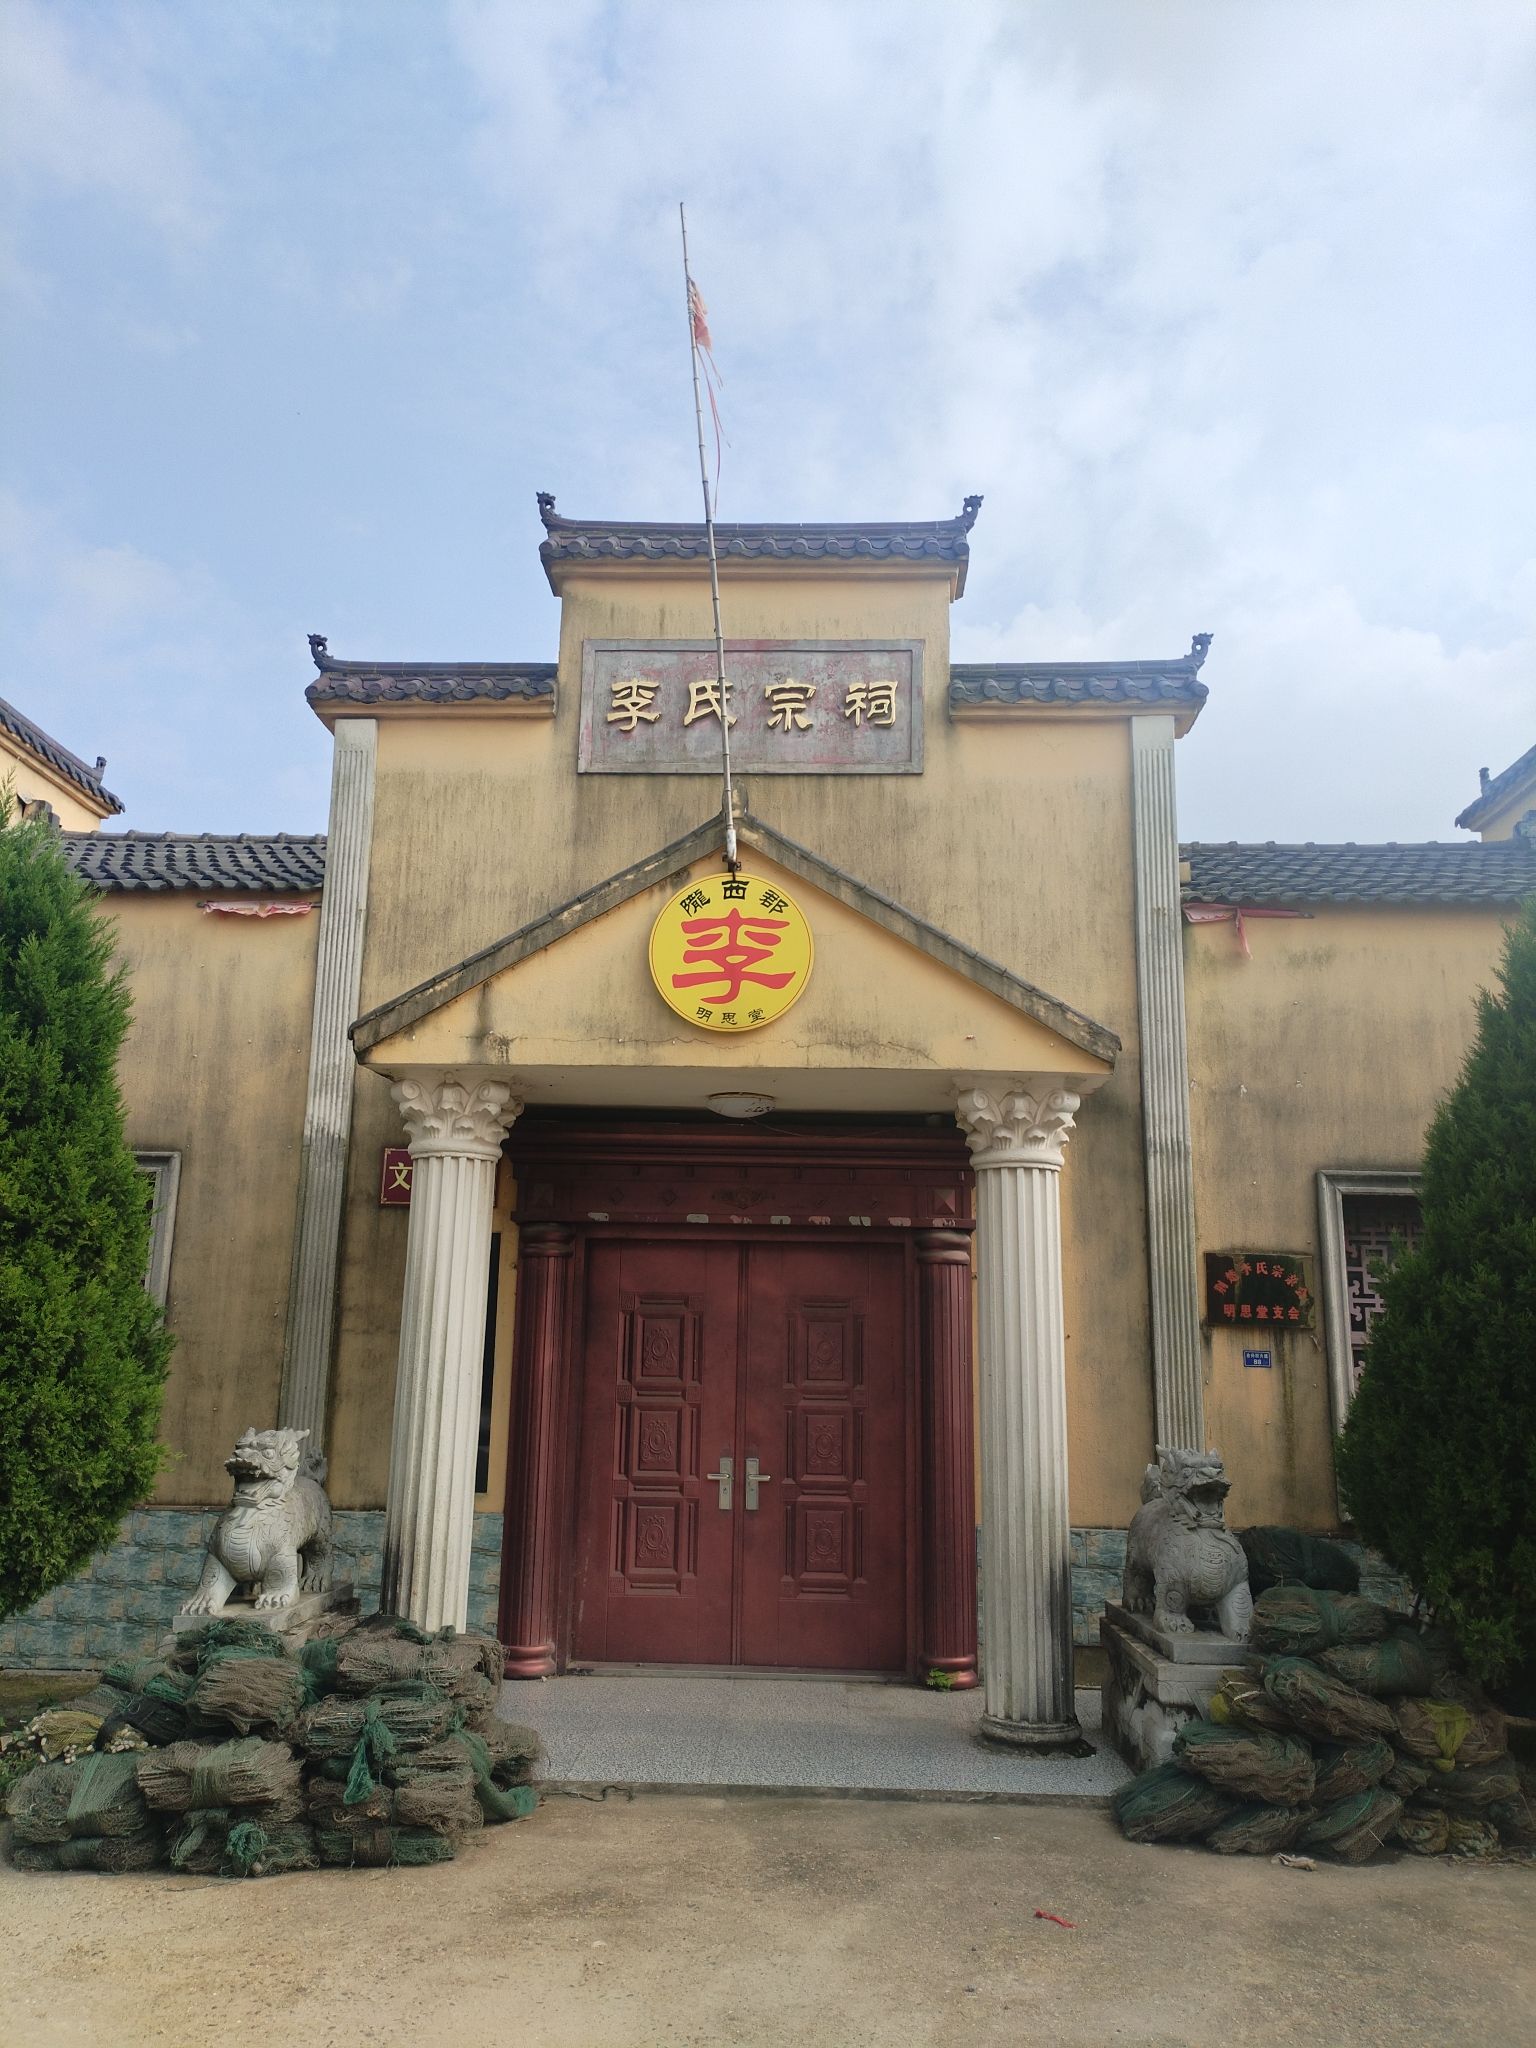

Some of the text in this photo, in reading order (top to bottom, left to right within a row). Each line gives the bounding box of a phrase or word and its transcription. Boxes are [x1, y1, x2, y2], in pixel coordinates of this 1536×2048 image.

[607, 678, 898, 732] 李氏宗祠
[672, 907, 796, 1005] 李
[696, 1006, 766, 1026] 明思堂
[388, 1162, 413, 1190] 文
[1223, 1303, 1300, 1320] 明思堂支会
